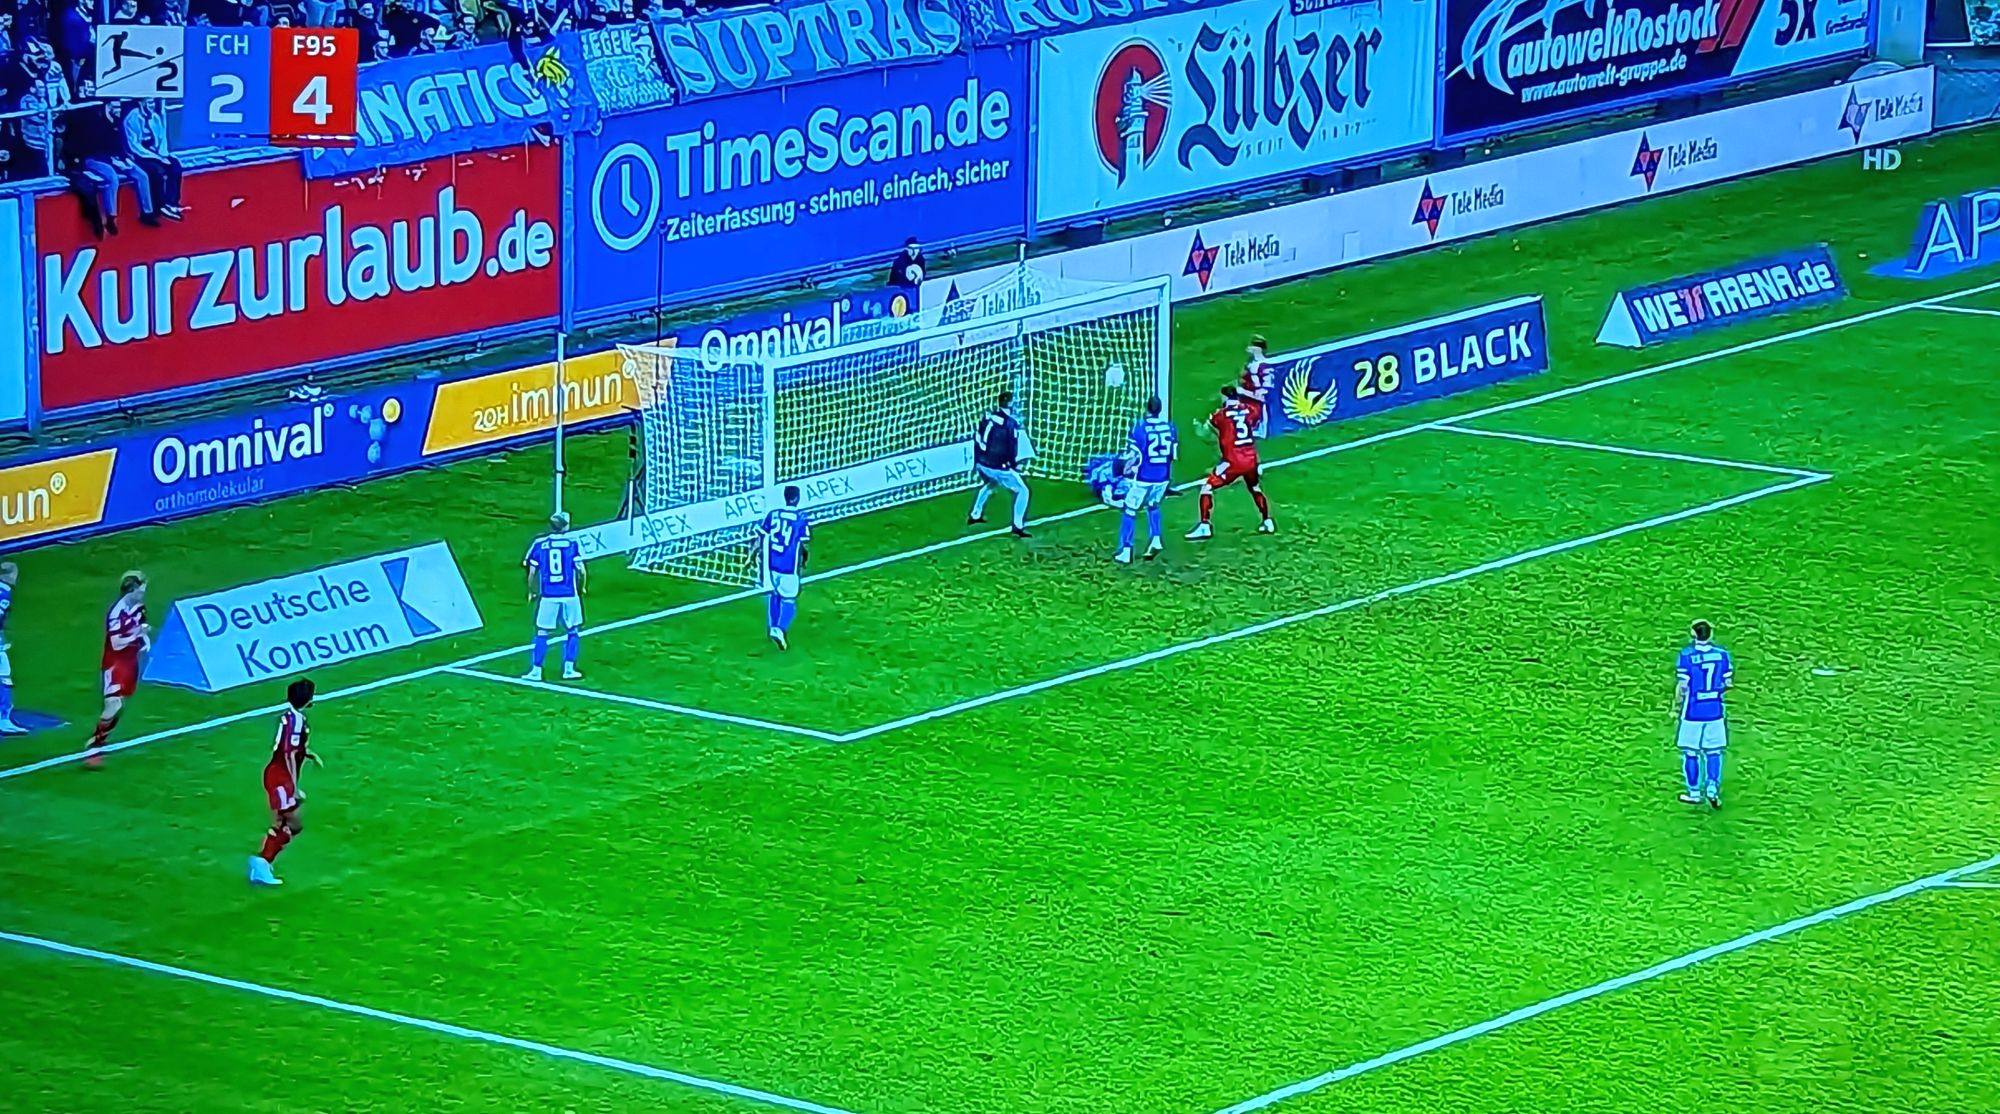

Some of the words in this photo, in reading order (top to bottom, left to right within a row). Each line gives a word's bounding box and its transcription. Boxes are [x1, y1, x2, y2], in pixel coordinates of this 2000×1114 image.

[663, 0, 960, 95] SUPTRAS
[345, 64, 548, 150] NATICS
[1178, 5, 1382, 172] Lübzer
[666, 78, 1010, 198] TimeScan.de
[666, 199, 796, 242] Zeiterfassung
[810, 179, 880, 215] schnell,
[883, 166, 953, 200] einfach,
[955, 159, 1010, 187] sicher
[45, 186, 554, 354] Kurzurlaub.de
[1353, 355, 1400, 399] 28
[1414, 322, 1532, 384] BLACK
[1147, 432, 1172, 457] 25
[1233, 415, 1249, 439] 3
[806, 476, 854, 502] APEX
[884, 456, 933, 484] APEX
[154, 475, 265, 513] orthomolekular
[724, 493, 766, 520] APE
[640, 513, 693, 542] APEX
[769, 511, 793, 543] 24
[549, 548, 563, 575] 8
[194, 564, 371, 638] Deutsche
[237, 618, 390, 678] Konsum
[1701, 662, 1716, 691] 7
